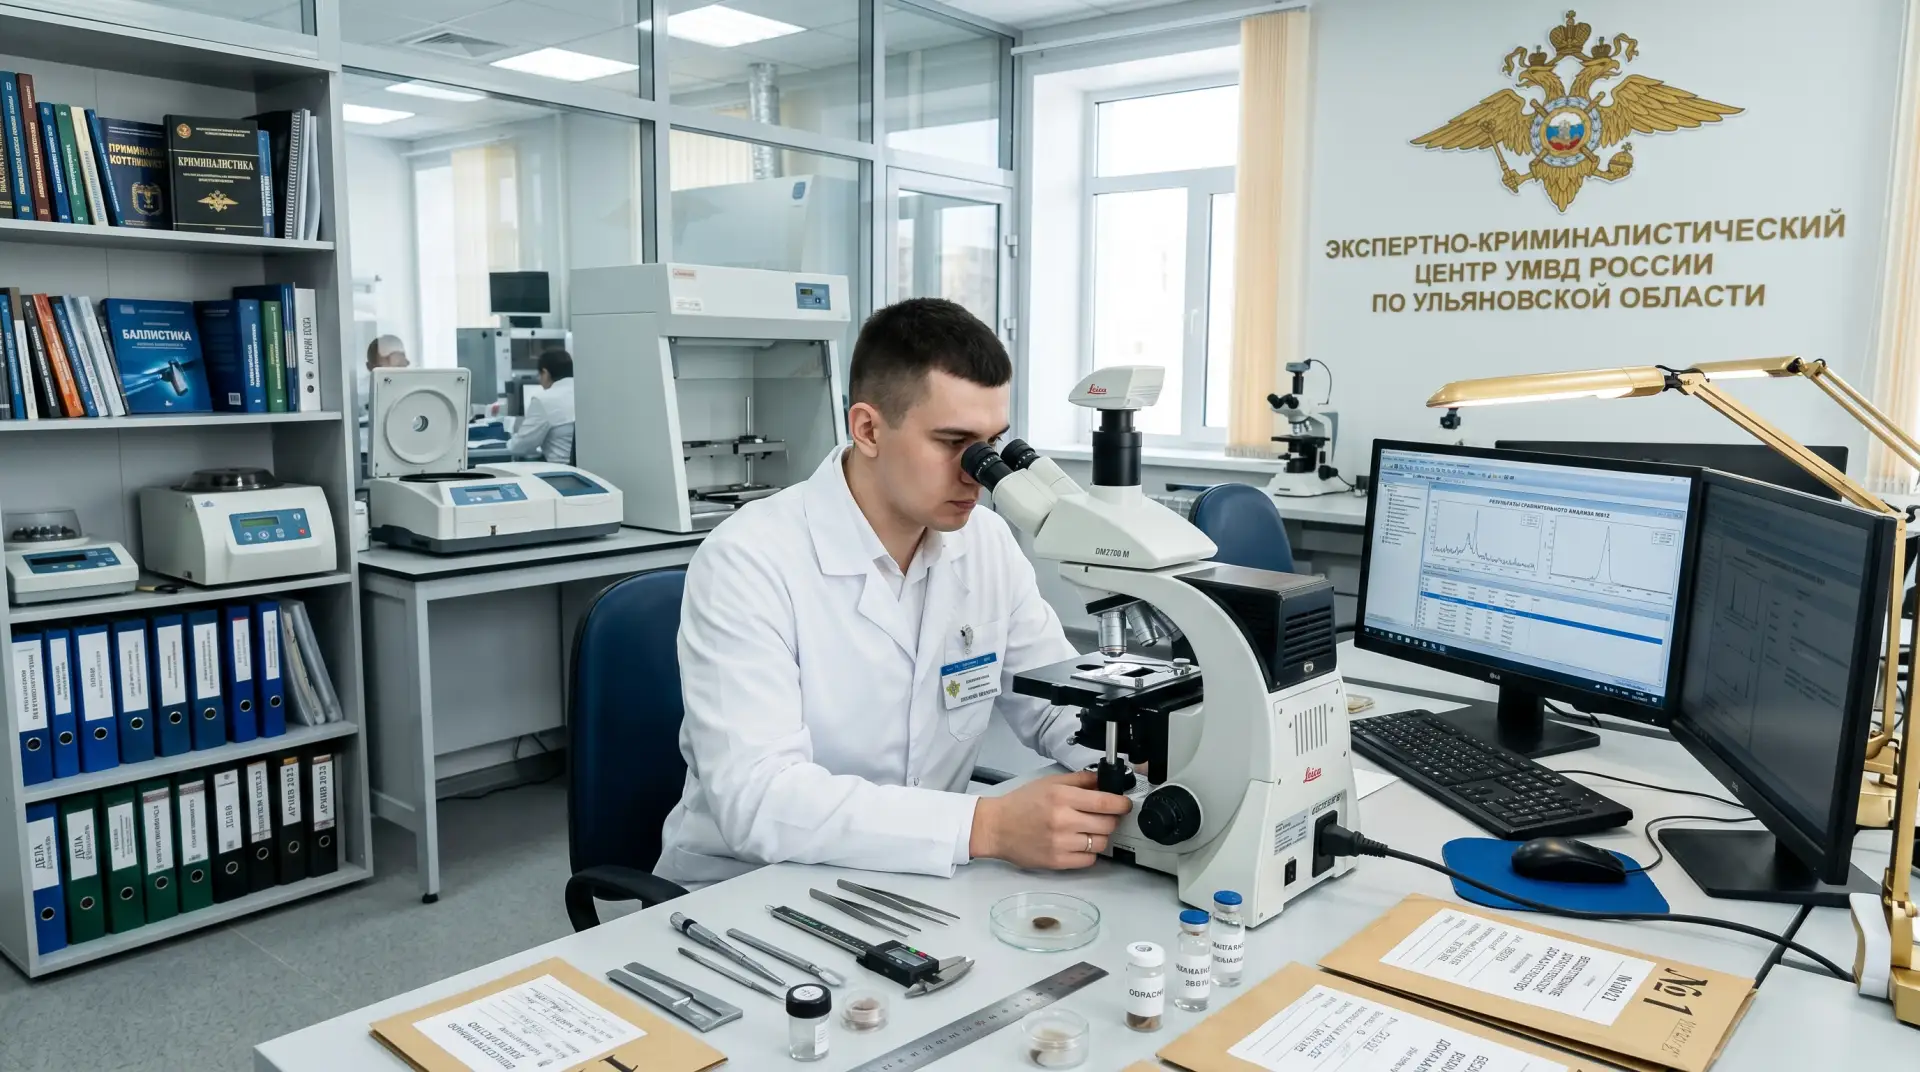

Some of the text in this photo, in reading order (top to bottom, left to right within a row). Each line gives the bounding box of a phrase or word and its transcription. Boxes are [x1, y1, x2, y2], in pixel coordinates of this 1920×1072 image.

[1325, 208, 1846, 259] ЭКСПЕРТНО-КРИМИНАЛИСТИЧЕСКИЙ
[1415, 253, 1714, 285] ЦЕНТР УМВД РОССИИ
[1372, 283, 1766, 313] ПО УЛЬЯНОВСКОЙ ОБЛАСТИ
[122, 329, 192, 341] БАЛЛИСТИКА
[1087, 383, 1107, 395] Leica
[1303, 767, 1322, 783] Leica
